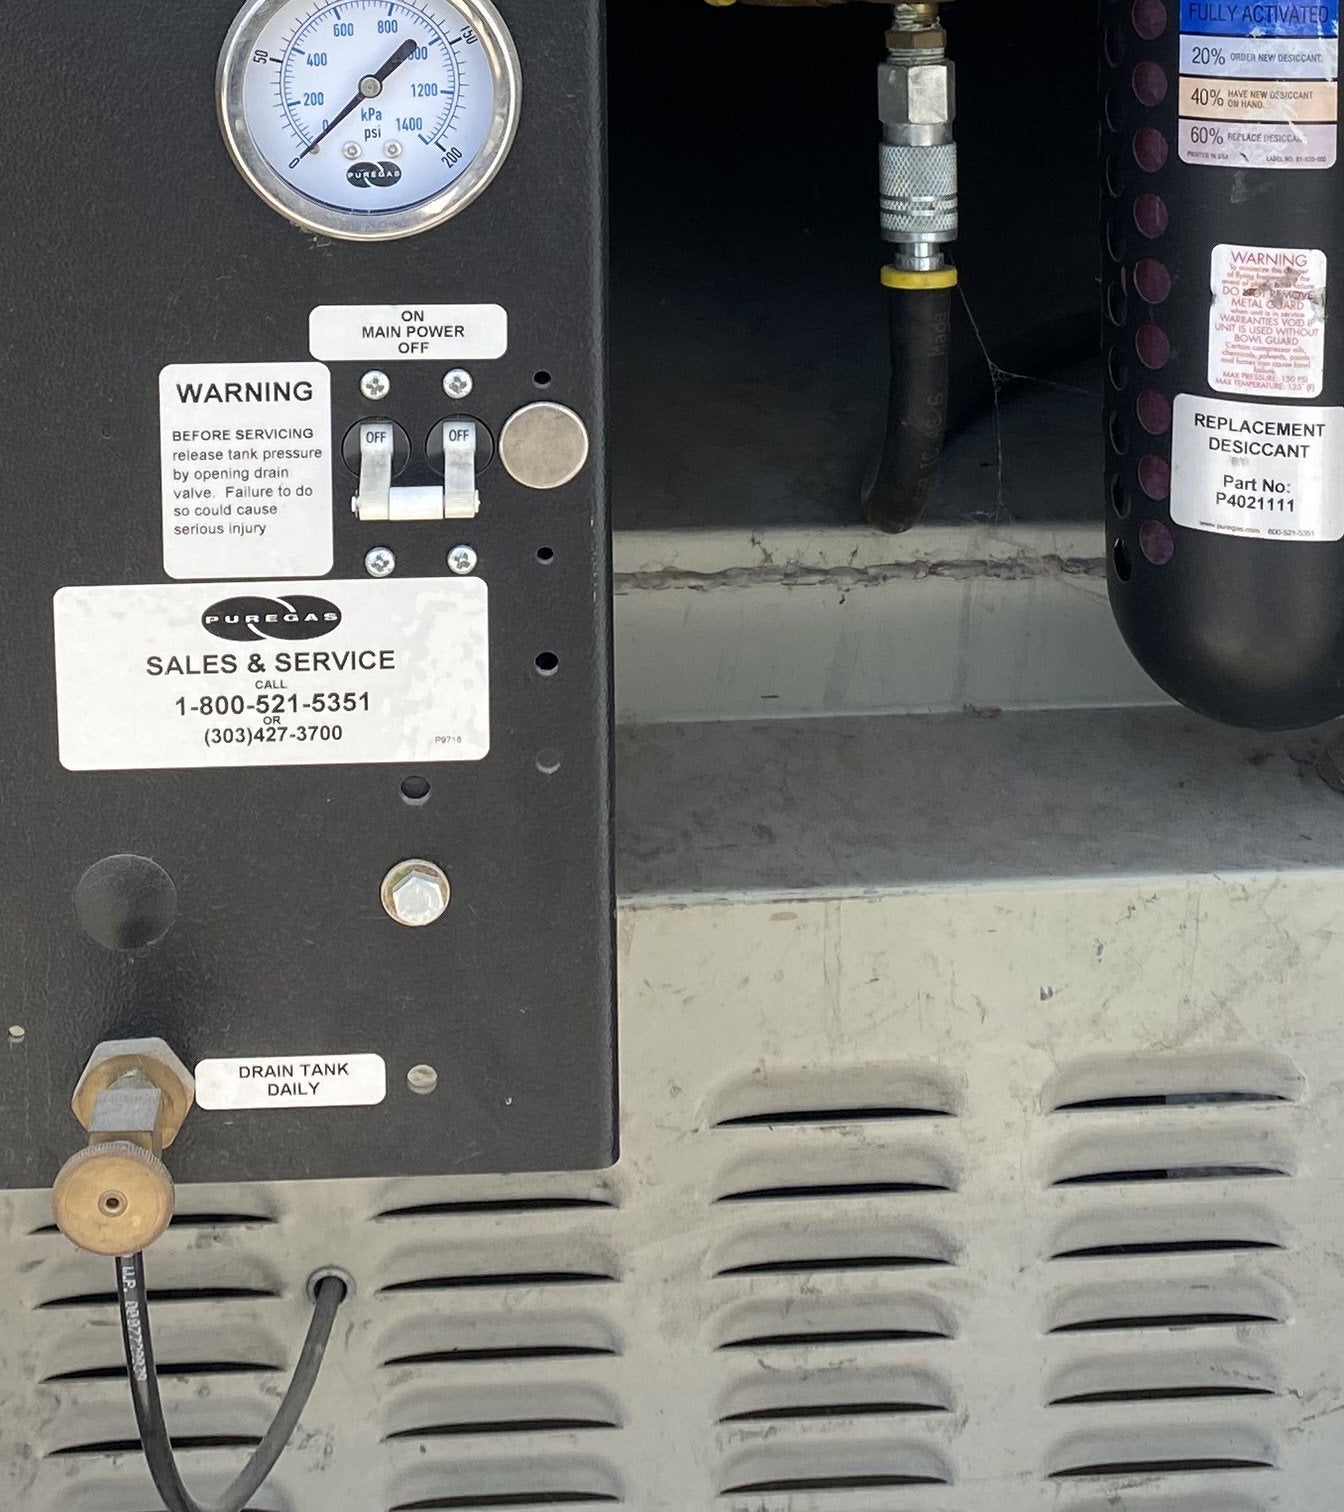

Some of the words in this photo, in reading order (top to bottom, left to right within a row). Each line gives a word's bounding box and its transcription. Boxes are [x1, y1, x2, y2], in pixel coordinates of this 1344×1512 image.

[1190, 3, 1237, 22] FULLY
[1242, 5, 1329, 24] ACTIVATED
[333, 22, 354, 37] 600
[378, 20, 398, 34] 800
[253, 50, 269, 65] 50
[306, 53, 328, 67] 400
[1192, 46, 1226, 66] 20%
[1230, 53, 1256, 62] ORDER
[1258, 54, 1276, 62] NEW
[304, 92, 324, 106] 200
[411, 83, 438, 98] 1200
[1190, 88, 1224, 106] 40%
[1228, 90, 1248, 98] HAVE
[1250, 90, 1268, 99] NEW
[360, 108, 382, 122] kPa
[395, 117, 423, 132] 1400
[364, 126, 382, 142] psi
[1190, 126, 1224, 144] 60%
[1228, 132, 1261, 142] REPLACE
[288, 158, 300, 170] 0
[440, 147, 463, 169] 200
[347, 168, 401, 180] PUREGAS
[1231, 251, 1308, 266] WARNING
[1222, 286, 1240, 296] DO
[1232, 298, 1262, 308] METAL
[1266, 300, 1304, 310] GUARD
[400, 310, 424, 322] ON
[1220, 314, 1278, 326] WARRANTIES
[1282, 318, 1304, 327] VOID
[361, 325, 402, 339] MAIN
[406, 324, 466, 338] POWER
[1216, 322, 1235, 332] UNIT
[1238, 325, 1246, 333] IS
[1249, 326, 1273, 336] USED
[1276, 328, 1319, 337] WITHOUT
[1234, 334, 1262, 344] BOWL
[1265, 336, 1298, 345] GUARD
[397, 341, 430, 354] OFF
[176, 380, 314, 404] WARNING
[1194, 412, 1326, 438] REPLACEMENT
[172, 429, 231, 442] BEFORE
[234, 428, 314, 440] SERVICING
[366, 430, 387, 444] OFF
[448, 428, 470, 442] OFF
[172, 448, 224, 461] release
[228, 446, 258, 460] tank
[262, 448, 322, 462] pressure
[1208, 437, 1310, 458] DESICCANT
[173, 467, 190, 483] by
[194, 467, 250, 482] opening
[254, 465, 289, 480] drain
[225, 484, 274, 498] Failure
[278, 484, 292, 498] to
[296, 484, 313, 497] do
[1224, 475, 1258, 492] Part
[1262, 478, 1290, 494] No:
[174, 506, 189, 516] so
[193, 503, 232, 516] could
[236, 504, 278, 516] cause
[1216, 492, 1294, 512] P4021111
[174, 522, 224, 536] serious
[228, 521, 266, 538] injury
[205, 612, 338, 624] PUREGAS
[146, 654, 238, 676] SALES
[248, 653, 266, 673] &
[275, 650, 395, 672] SERVICE
[255, 680, 287, 690] CALL
[175, 692, 370, 716] 1-800-521-5351
[264, 715, 280, 726] OR
[204, 725, 343, 746] (303)427-3700
[239, 1064, 294, 1079] DRAIN
[298, 1062, 350, 1076] TANK
[268, 1082, 320, 1097] DAILY
